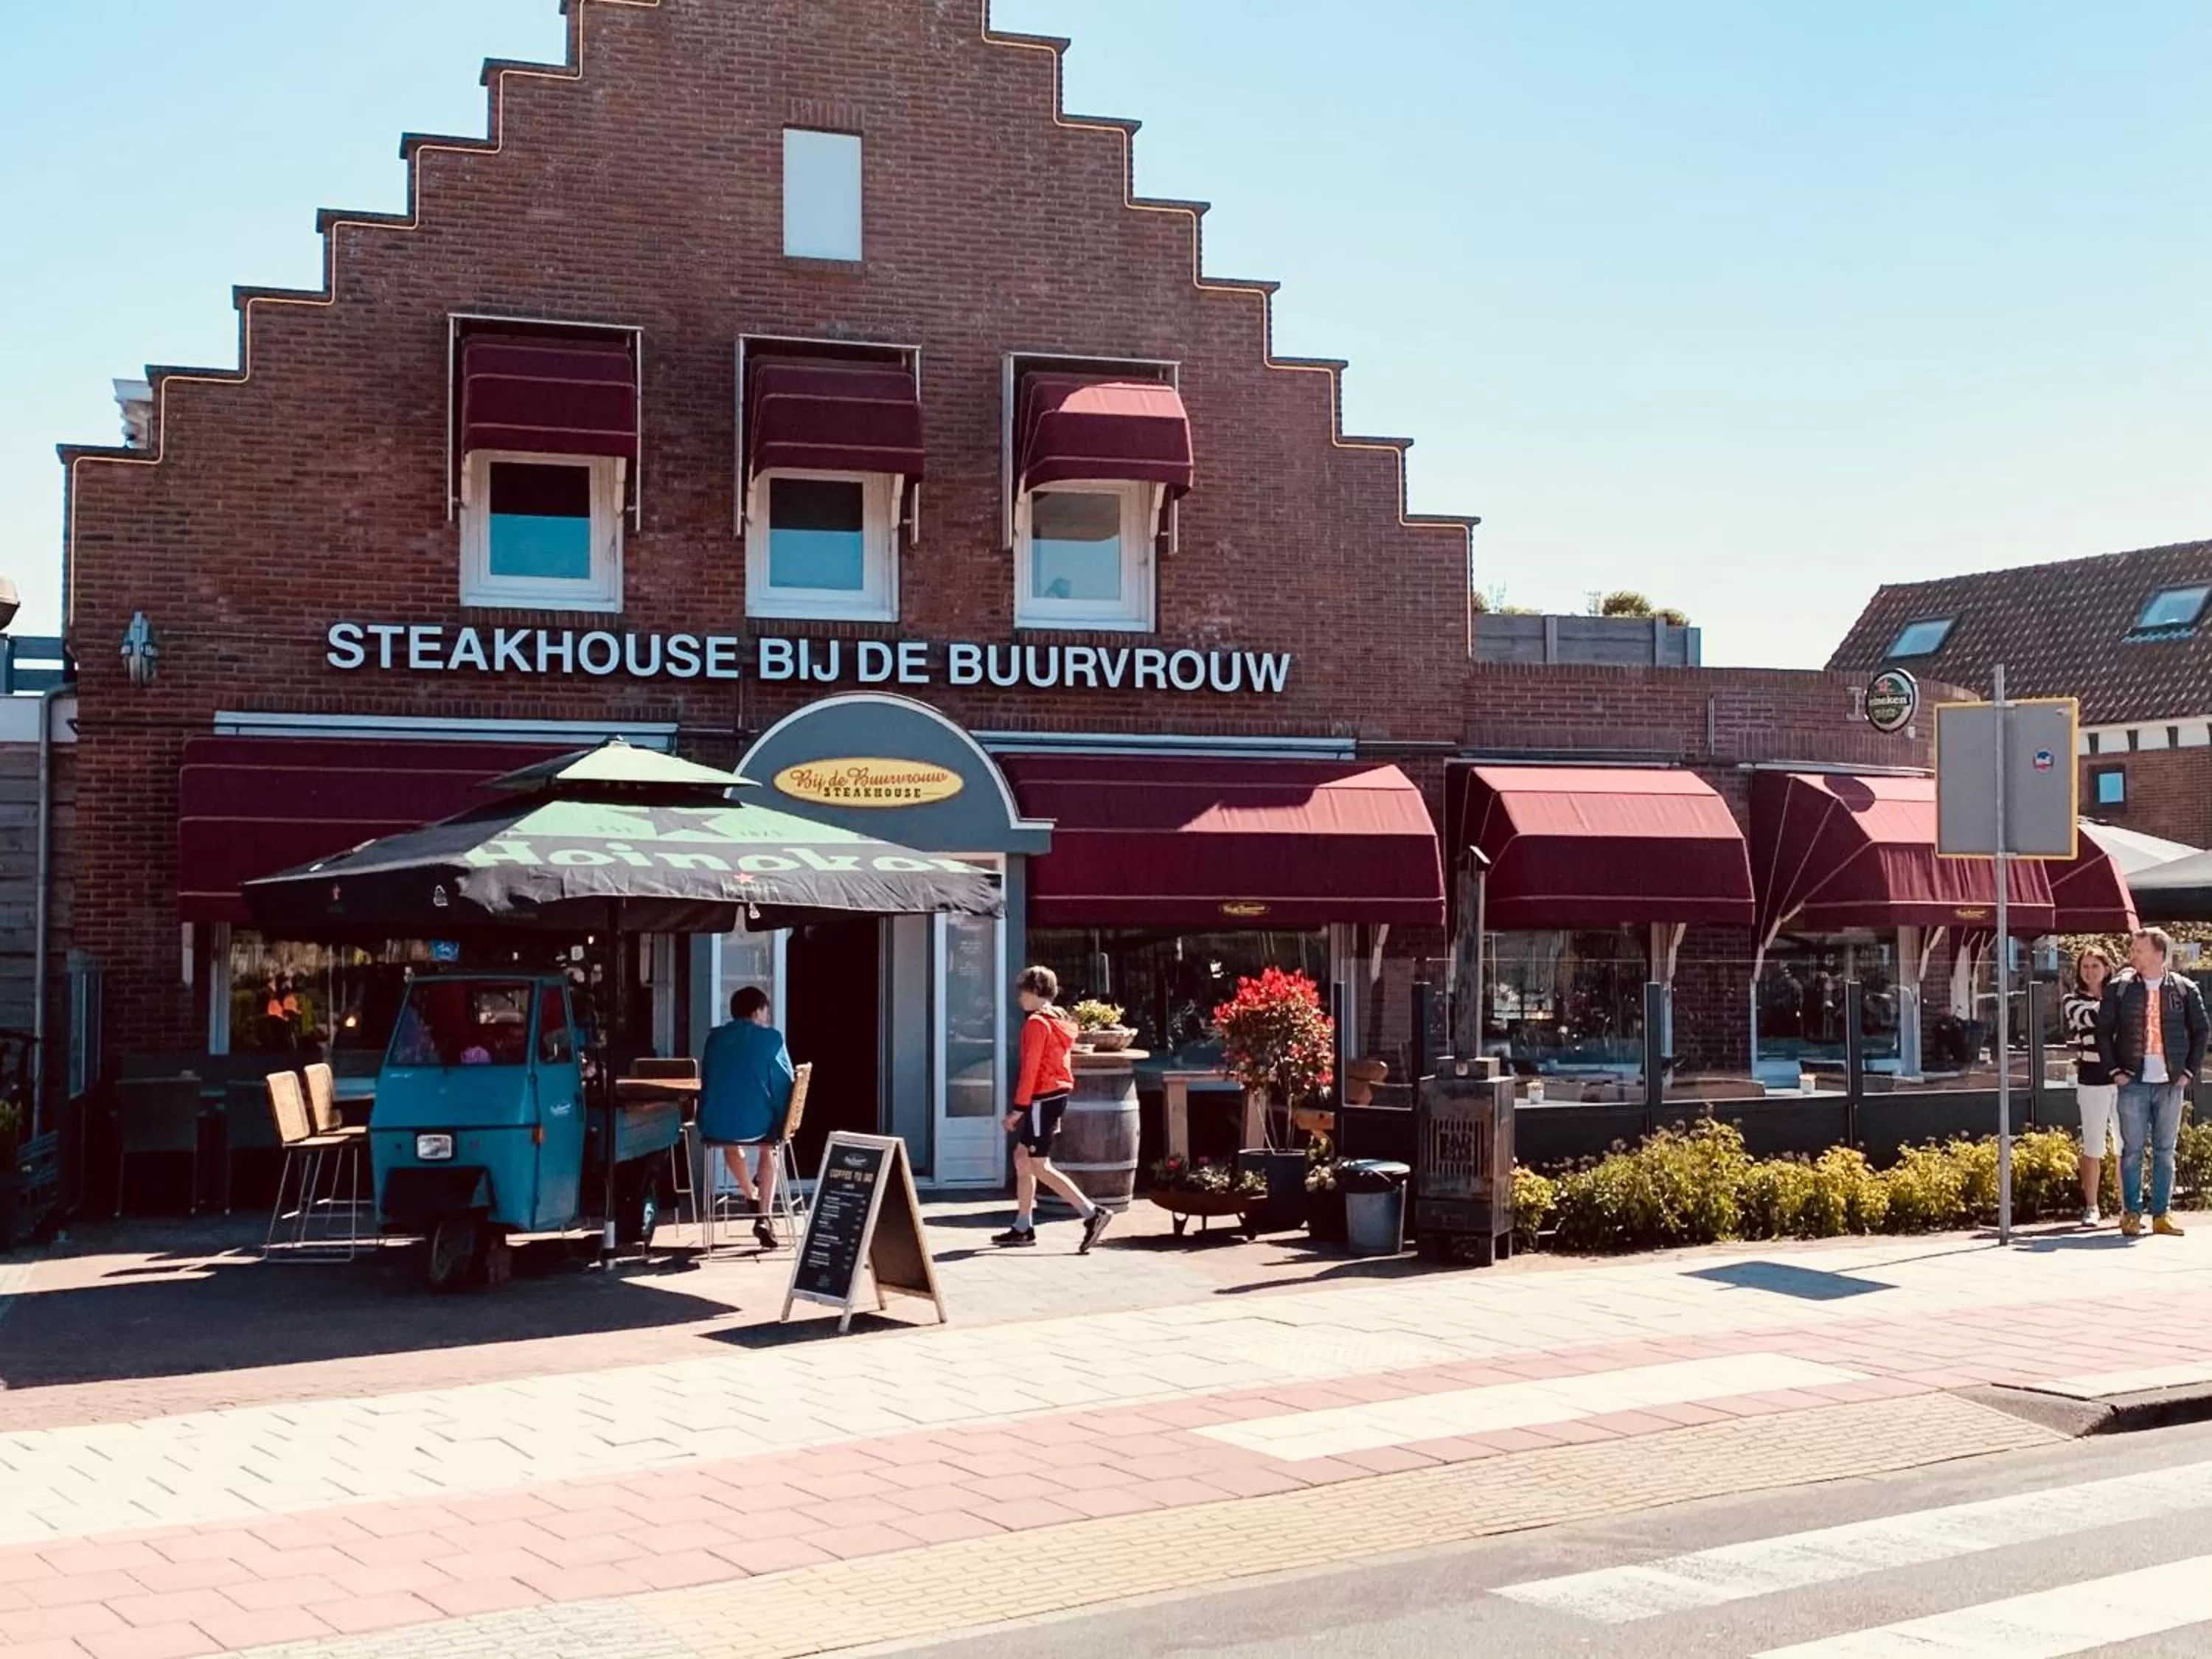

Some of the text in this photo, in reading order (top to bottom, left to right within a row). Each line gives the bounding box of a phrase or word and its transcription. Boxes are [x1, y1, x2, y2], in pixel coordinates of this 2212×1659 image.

[327, 623, 1290, 693] STEAKHOUSE BIJ DE BUURVROUW
[790, 767, 948, 793] Bij de Buurvrouw
[824, 787, 921, 798] STEAKHOUSE
